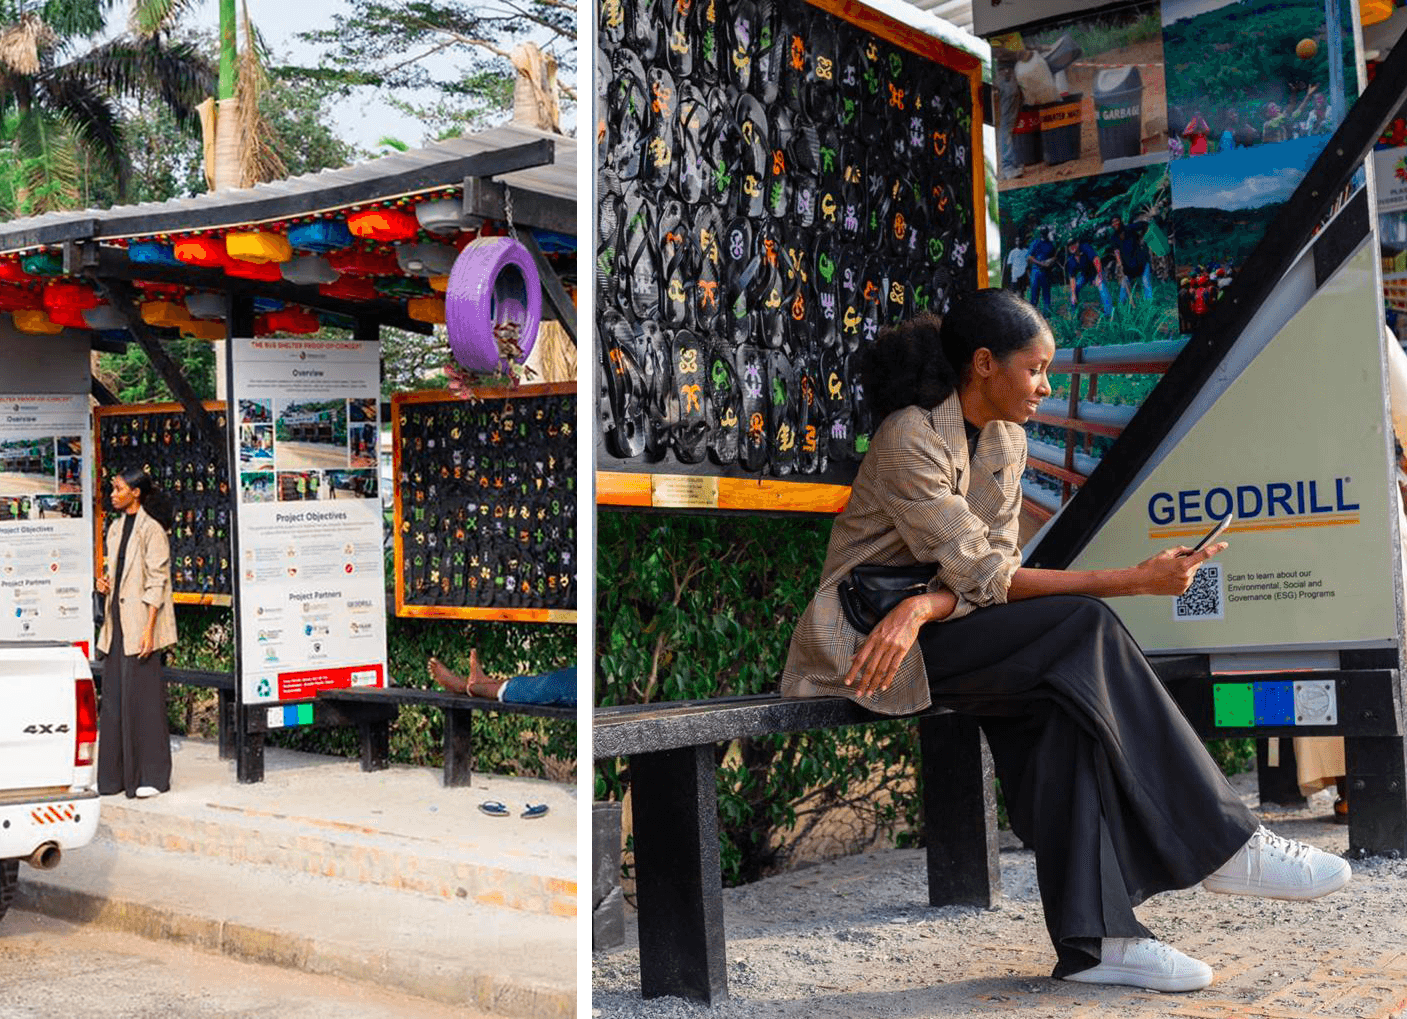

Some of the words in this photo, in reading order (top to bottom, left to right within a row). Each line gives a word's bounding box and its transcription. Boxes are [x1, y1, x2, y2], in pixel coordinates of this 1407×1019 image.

[1148, 478, 1360, 525] GEODRILL
[276, 512, 305, 523] Project
[306, 511, 347, 522] Objectives
[1227, 573, 1245, 582] Scan
[1256, 572, 1274, 580] learn
[1276, 571, 1297, 579] about
[1228, 582, 1282, 592] Environmental,
[1283, 580, 1306, 589] Social
[1308, 580, 1322, 588] and
[289, 592, 313, 602] Project
[314, 591, 342, 599] Partners
[1228, 592, 1272, 602] Governance
[1274, 591, 1297, 601] (ESG)
[1299, 590, 1335, 600] Programs
